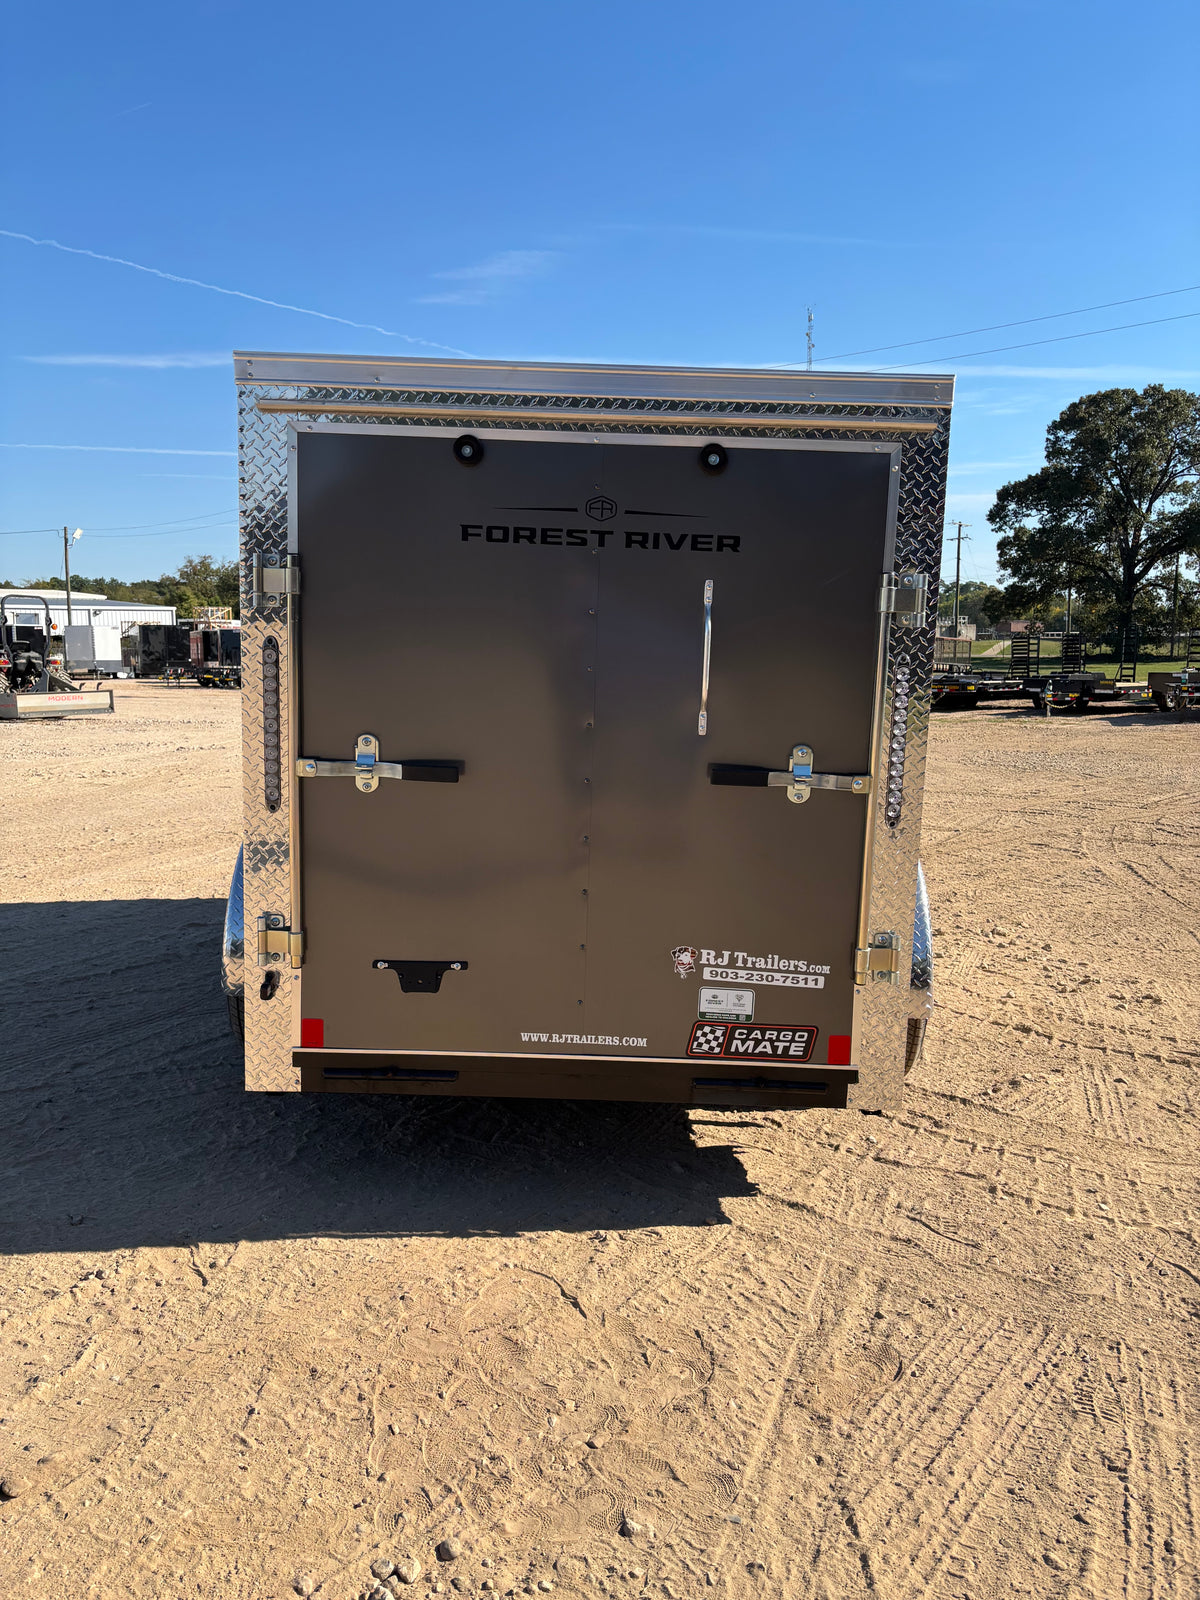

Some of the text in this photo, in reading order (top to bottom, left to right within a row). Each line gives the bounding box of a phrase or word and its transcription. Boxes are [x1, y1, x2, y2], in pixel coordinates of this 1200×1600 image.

[460, 524, 741, 553] FOREST RIVER
[700, 949, 731, 966] RJ
[709, 969, 820, 986] 903-230-7511
[520, 1032, 647, 1047] WWW.RJTRAILERS.COM
[734, 1029, 809, 1042] CARGO
[730, 1039, 806, 1055] MATE
